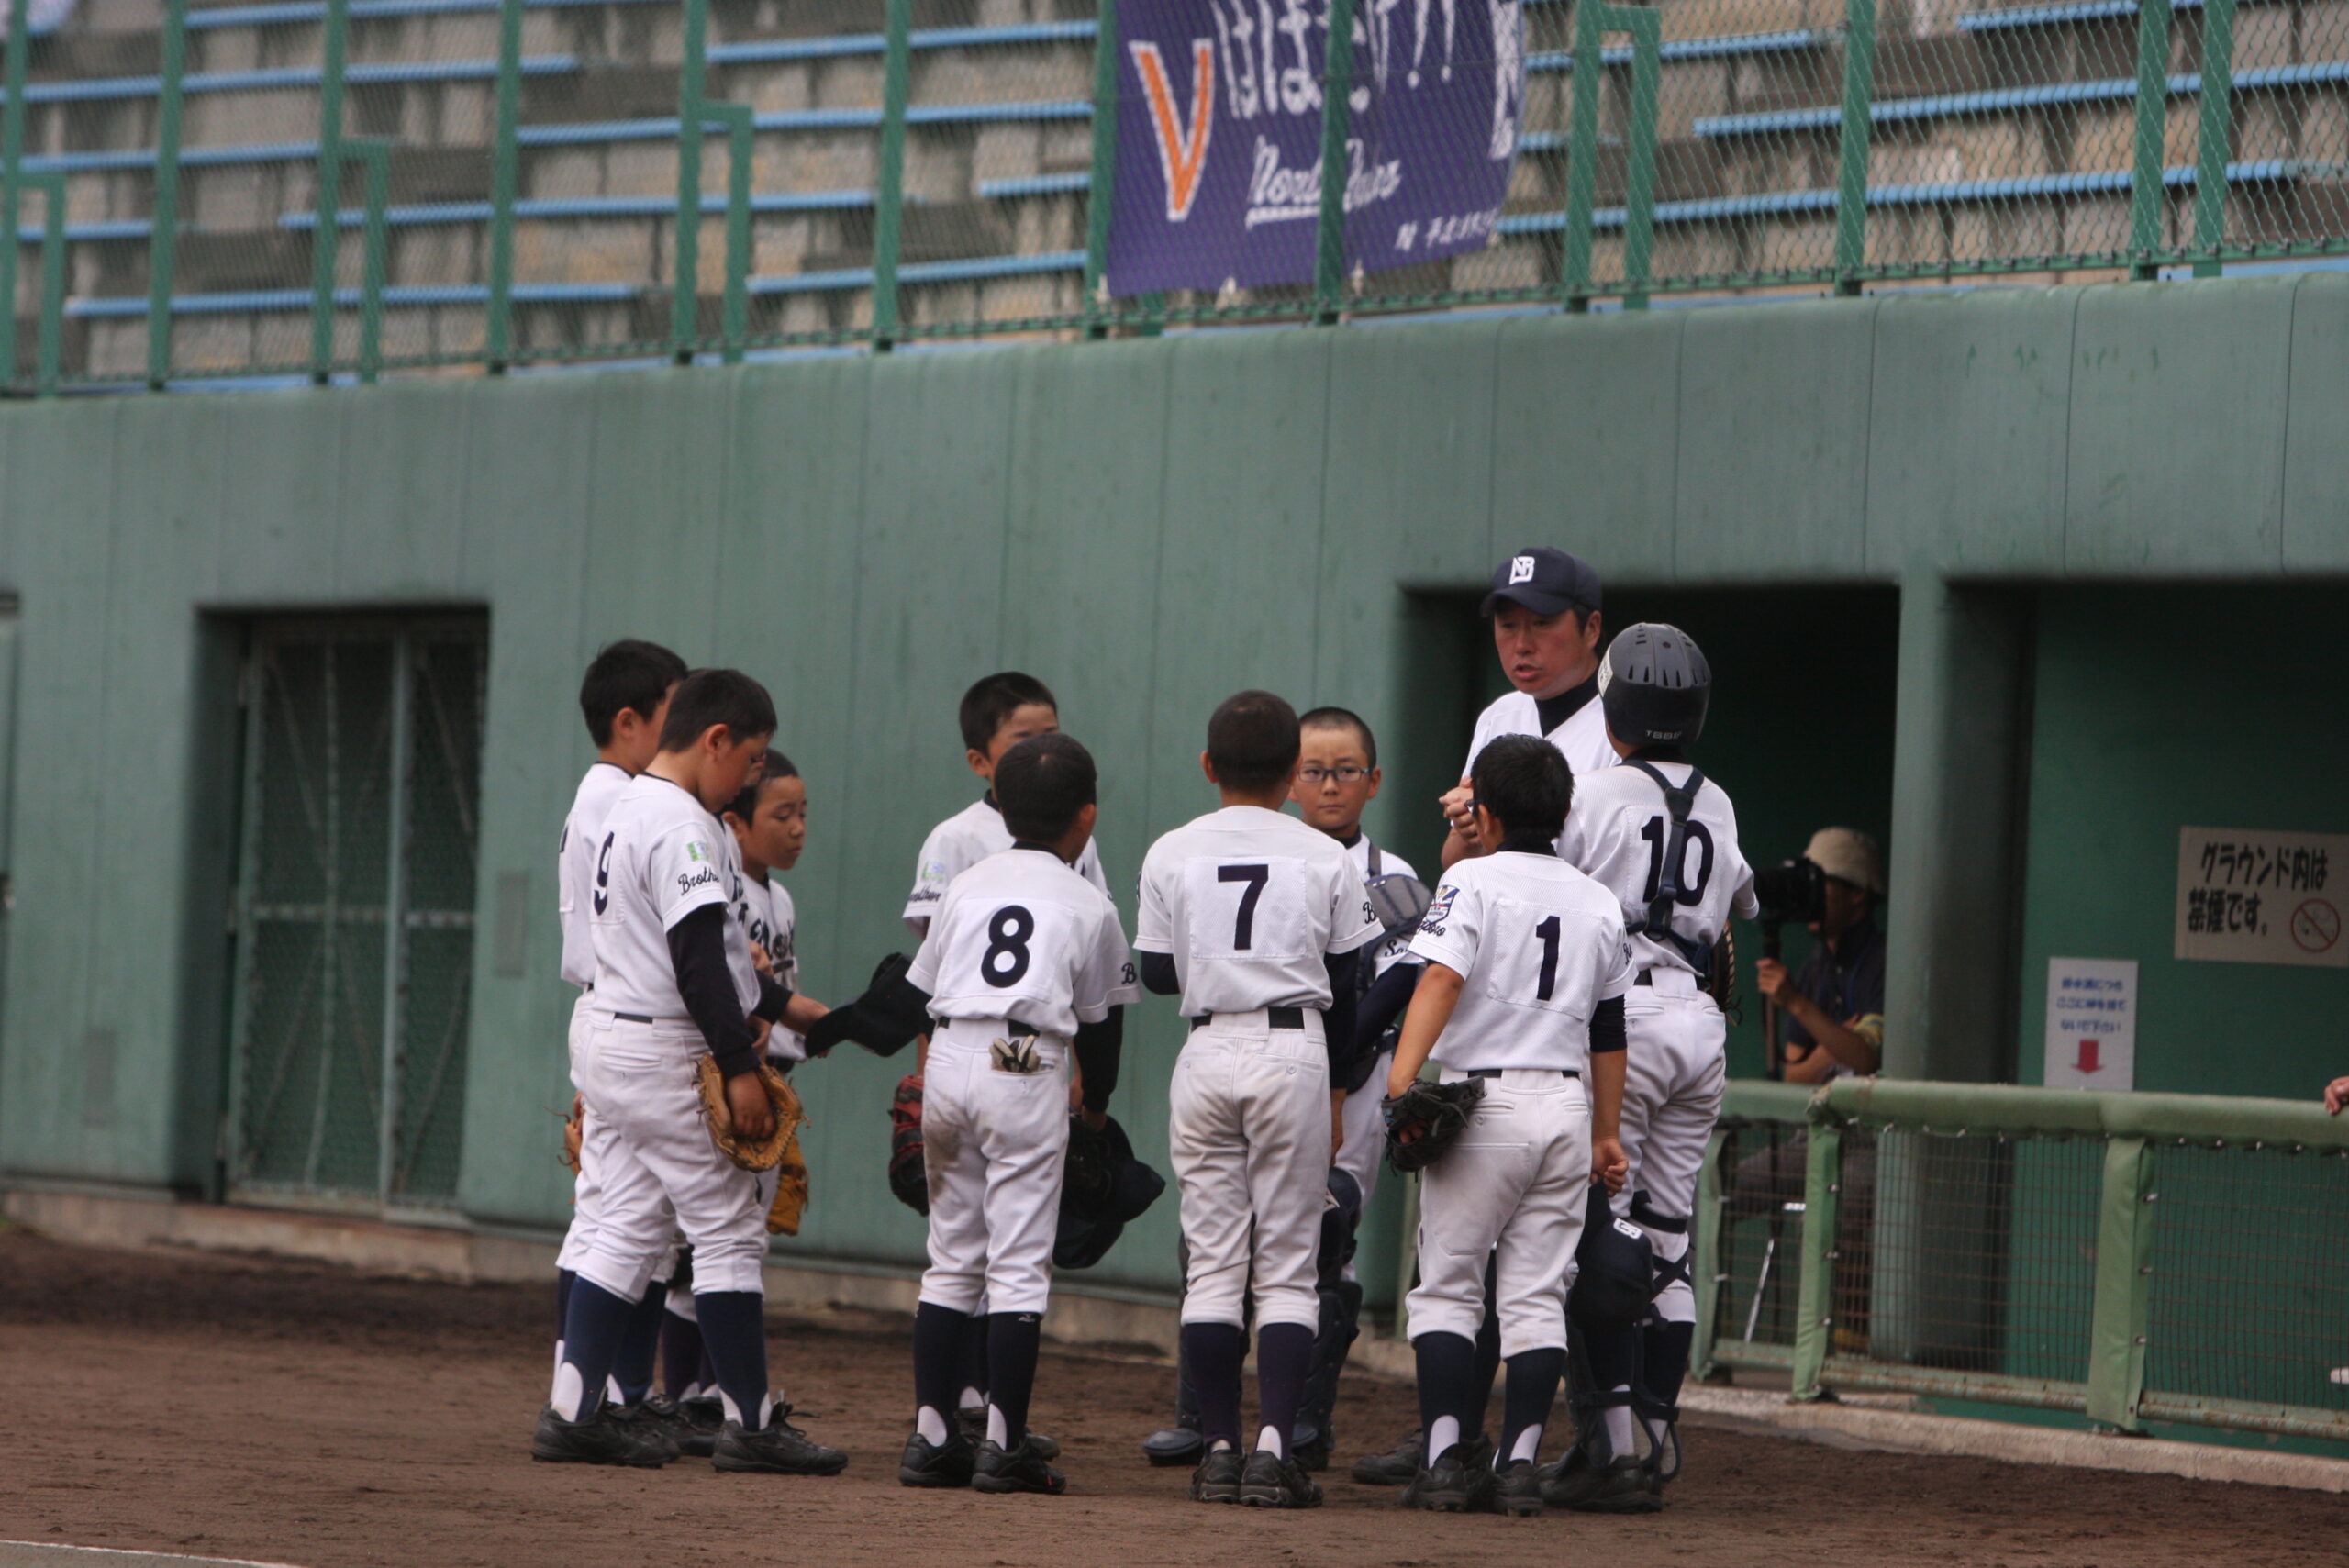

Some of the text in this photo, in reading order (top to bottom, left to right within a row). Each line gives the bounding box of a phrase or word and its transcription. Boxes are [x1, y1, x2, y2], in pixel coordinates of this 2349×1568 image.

[1129, 38, 1214, 223] V
[594, 830, 615, 916] 9
[1641, 815, 1715, 907] 10
[2201, 841, 2328, 892] グラウンド内は
[981, 905, 1035, 988] 8
[1218, 863, 1269, 951] 7
[2188, 886, 2268, 936] 禁煙です。
[1536, 915, 1561, 1002] 1
